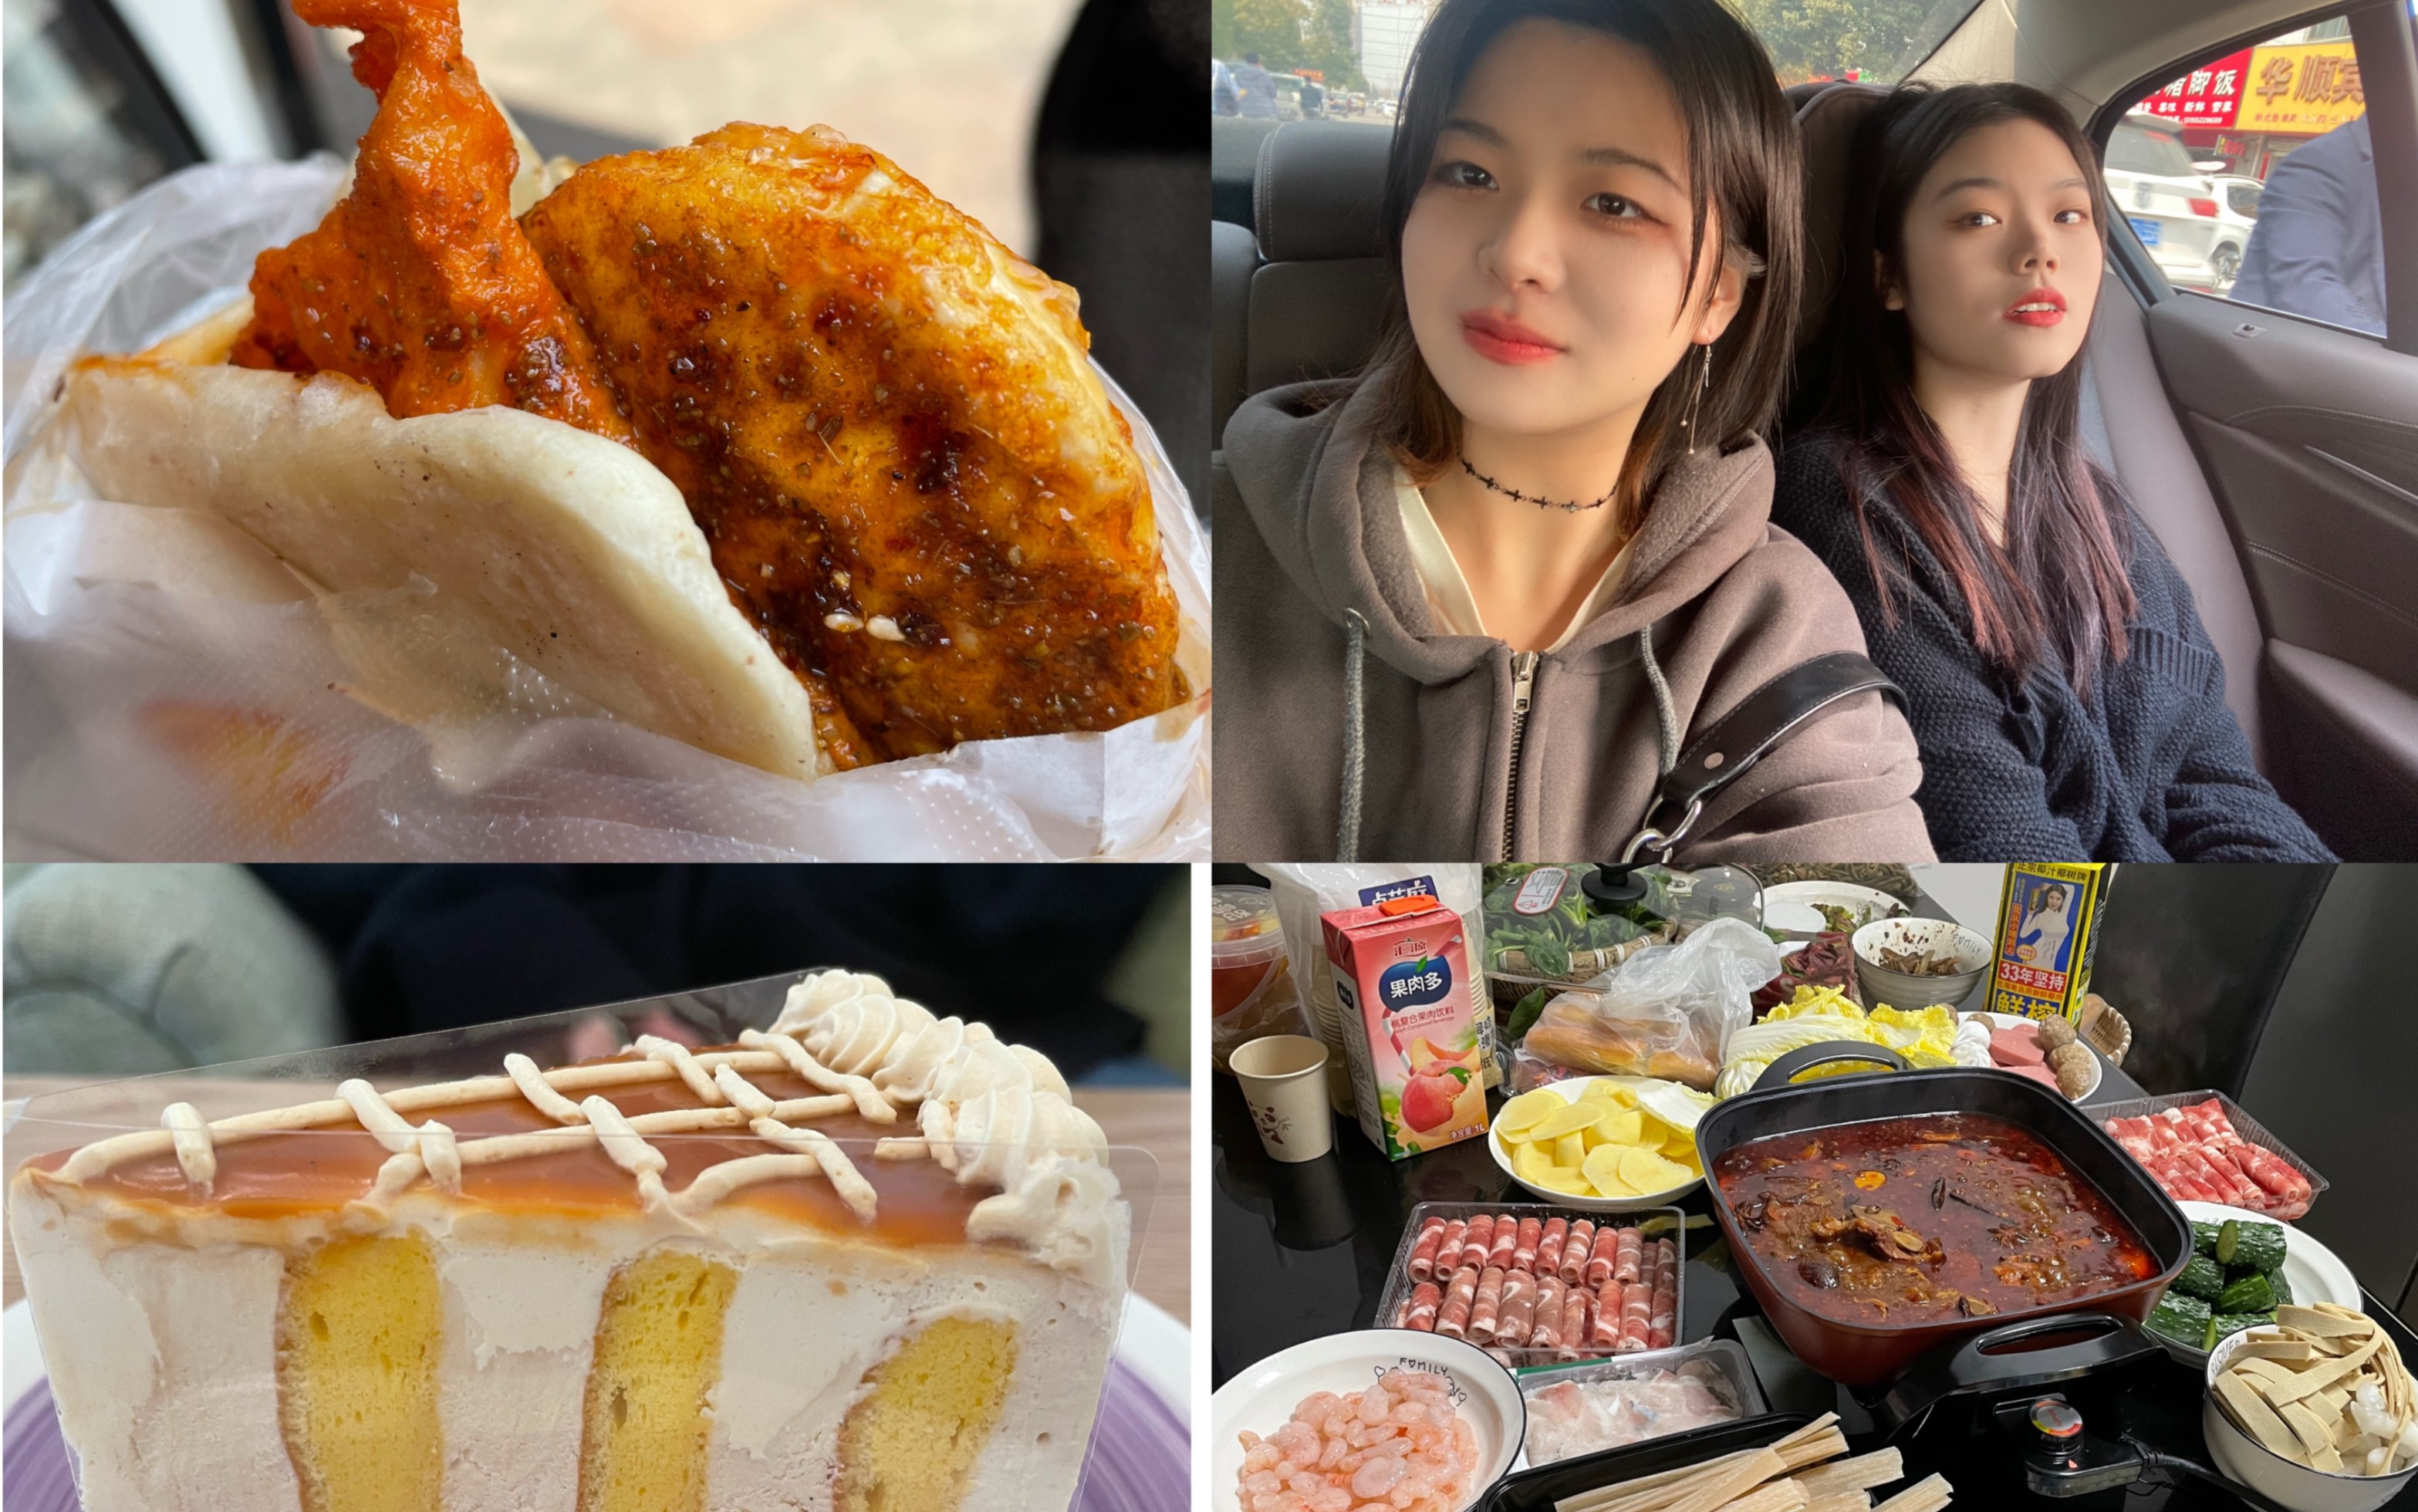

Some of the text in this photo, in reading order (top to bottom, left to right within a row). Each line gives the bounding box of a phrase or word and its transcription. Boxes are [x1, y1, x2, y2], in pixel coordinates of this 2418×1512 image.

[2155, 69, 2237, 97] 猪脚饭
[2256, 54, 2365, 106] 华顺宾
[1390, 971, 1443, 999] 果肉多
[2000, 963, 2065, 991] 33年坚持
[1391, 1005, 1454, 1029] 桃复合果肉饮料
